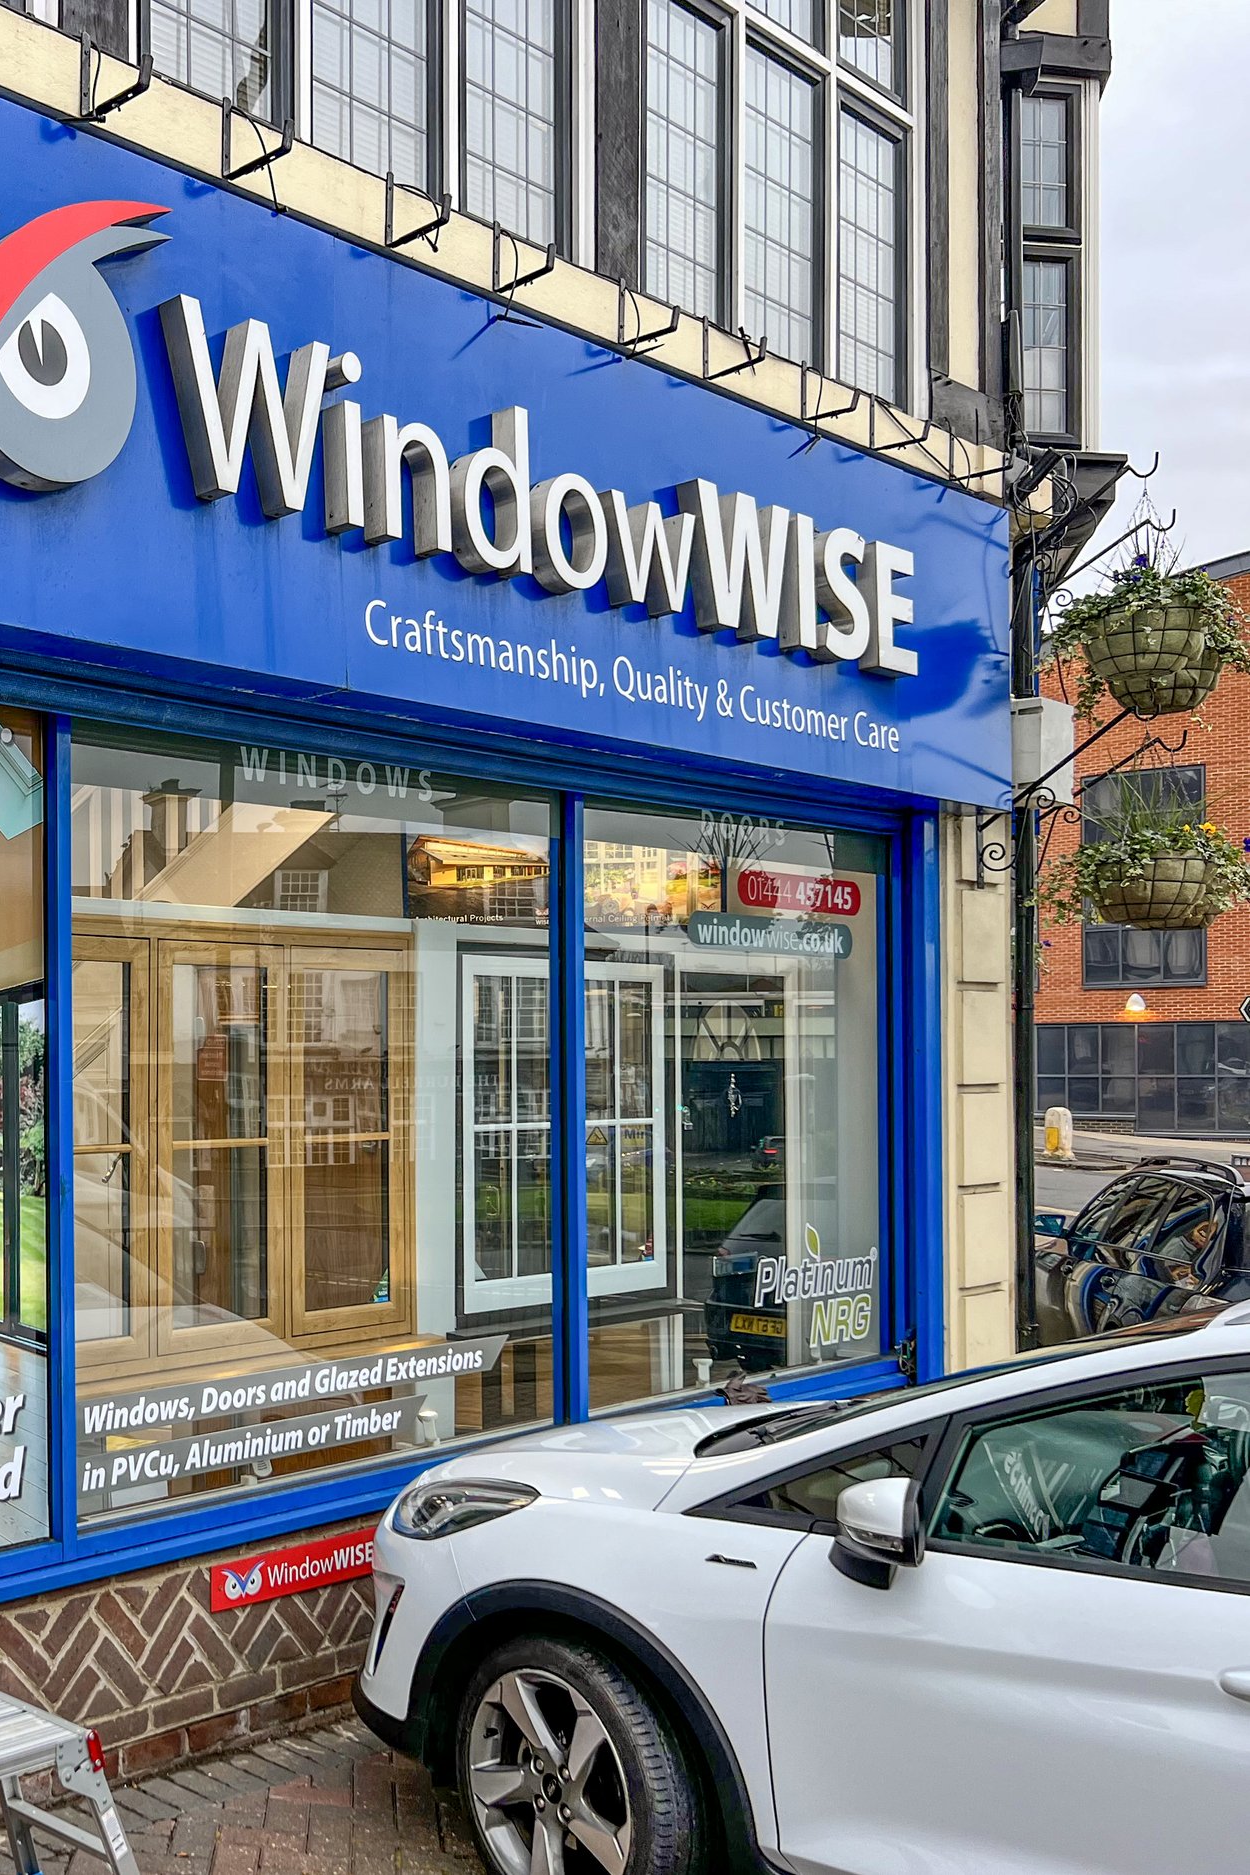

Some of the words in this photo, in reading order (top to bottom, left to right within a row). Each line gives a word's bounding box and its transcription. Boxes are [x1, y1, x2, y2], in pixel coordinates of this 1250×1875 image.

[161, 294, 918, 677] WindowWISE
[364, 600, 605, 697] Craftsmanship,
[613, 655, 708, 722] Quality
[715, 679, 735, 715] &
[740, 687, 848, 740] Customer
[854, 710, 899, 753] Care
[240, 746, 433, 801] WINDOWS
[701, 809, 785, 846] DOORS
[470, 914, 503, 923] Projects
[608, 914, 638, 923] Ceiling
[747, 876, 792, 903] 01444
[796, 881, 852, 910] 457145
[697, 919, 844, 954] windowwise.co.uk
[810, 1294, 872, 1349] NRG
[84, 1396, 195, 1435] Windows,
[201, 1383, 266, 1414] Doors
[271, 1371, 310, 1401] and
[315, 1358, 382, 1394] Glazed
[386, 1347, 483, 1385] Extensions
[82, 1462, 105, 1492] in
[111, 1450, 180, 1486] PVCu,
[185, 1429, 303, 1471] Aluminium
[307, 1423, 330, 1447] or
[334, 1408, 401, 1441] Timber
[267, 1540, 373, 1588] WindowWISE
